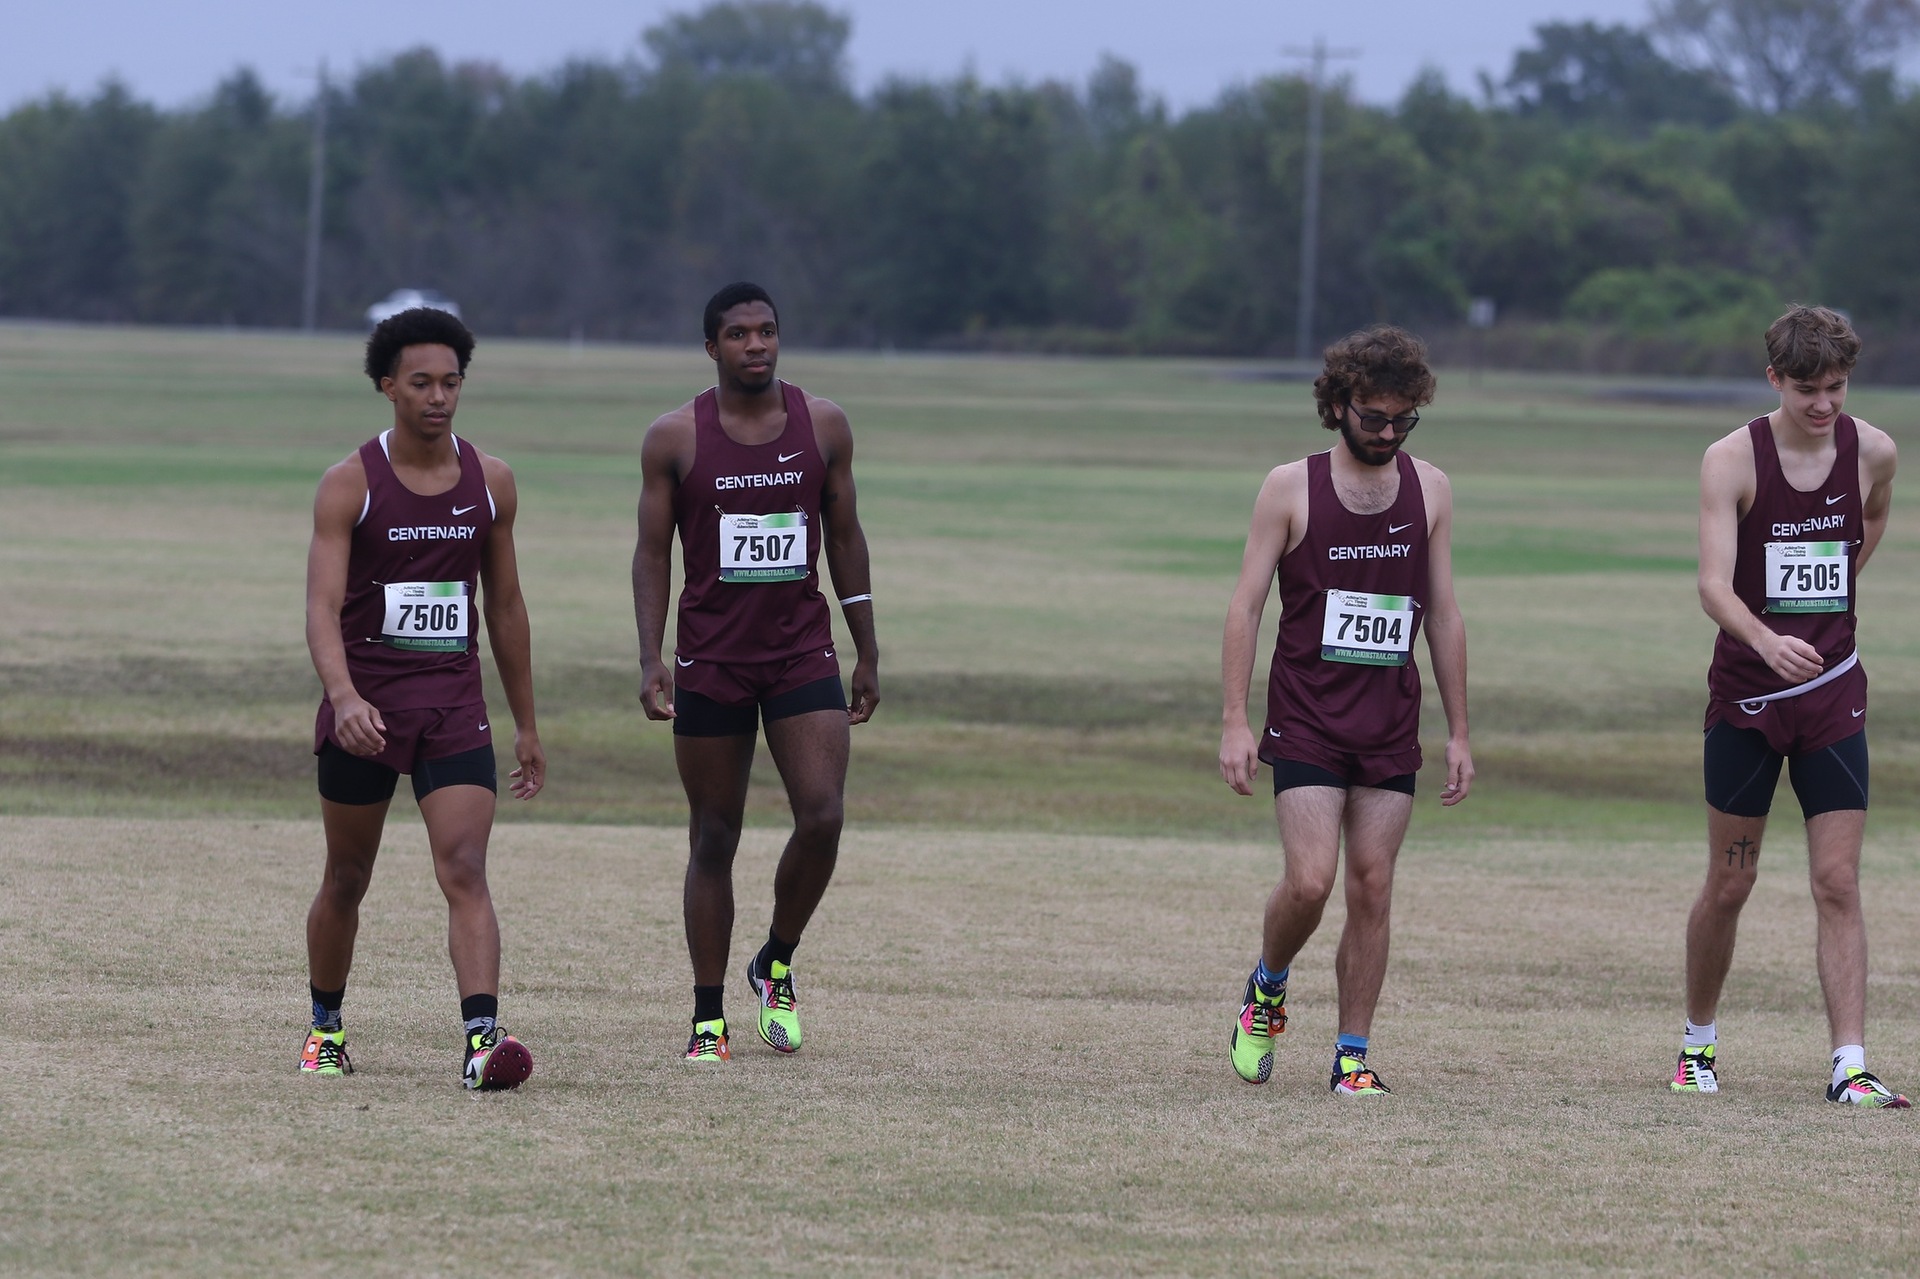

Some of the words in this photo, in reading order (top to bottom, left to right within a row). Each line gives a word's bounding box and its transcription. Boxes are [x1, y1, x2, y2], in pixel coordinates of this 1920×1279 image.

[715, 471, 804, 490] CENTENARY
[388, 526, 476, 541] CENTENARY
[733, 534, 796, 562] 7507
[1328, 544, 1411, 560] CENTENARY
[1780, 563, 1840, 591] 7505
[397, 603, 459, 631] 7506
[1337, 613, 1402, 645] 7504
